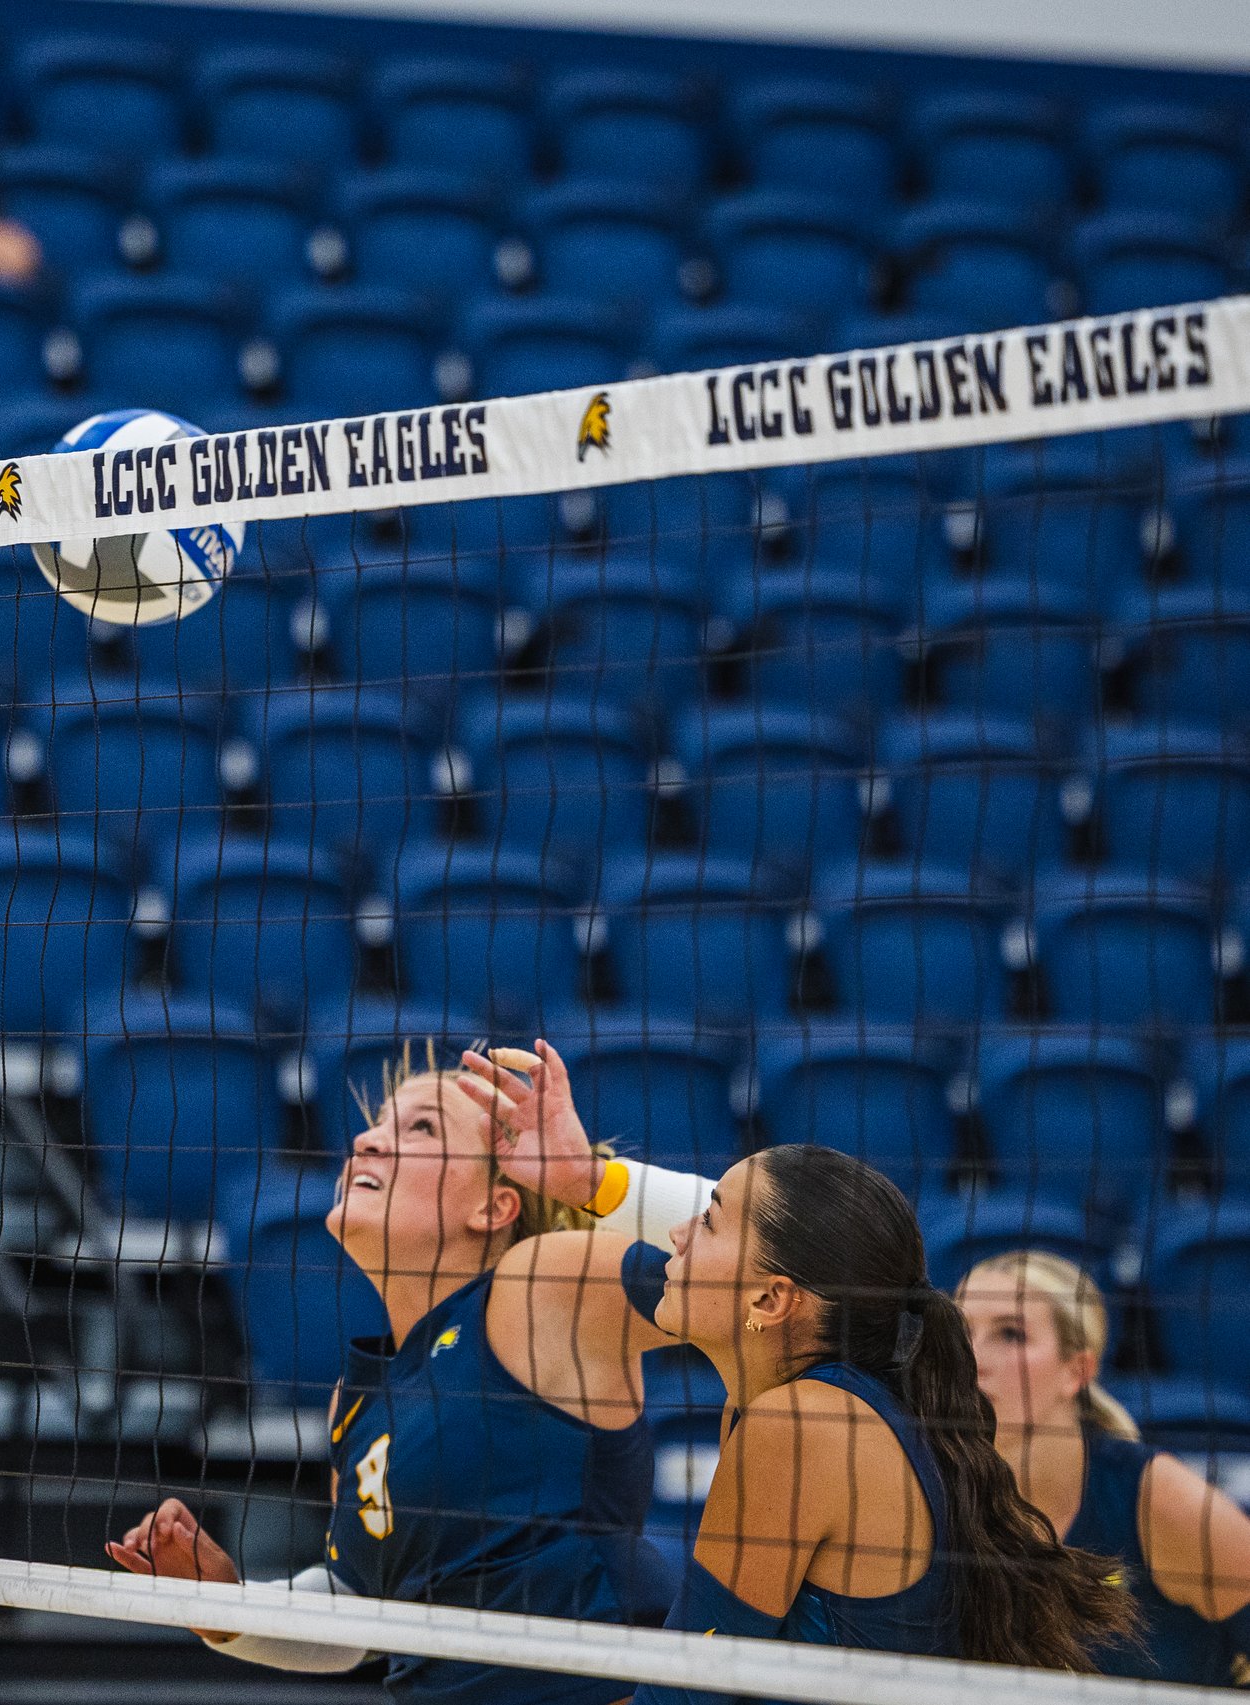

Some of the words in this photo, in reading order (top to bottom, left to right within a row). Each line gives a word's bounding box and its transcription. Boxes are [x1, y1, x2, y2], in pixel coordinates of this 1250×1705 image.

[706, 366, 813, 445] LCCC
[827, 341, 1008, 429] GOLDEN
[1027, 314, 1211, 407] EAGLES
[93, 443, 177, 517] LCCC
[191, 425, 330, 505] GOLDEN
[347, 407, 488, 487] EAGLES
